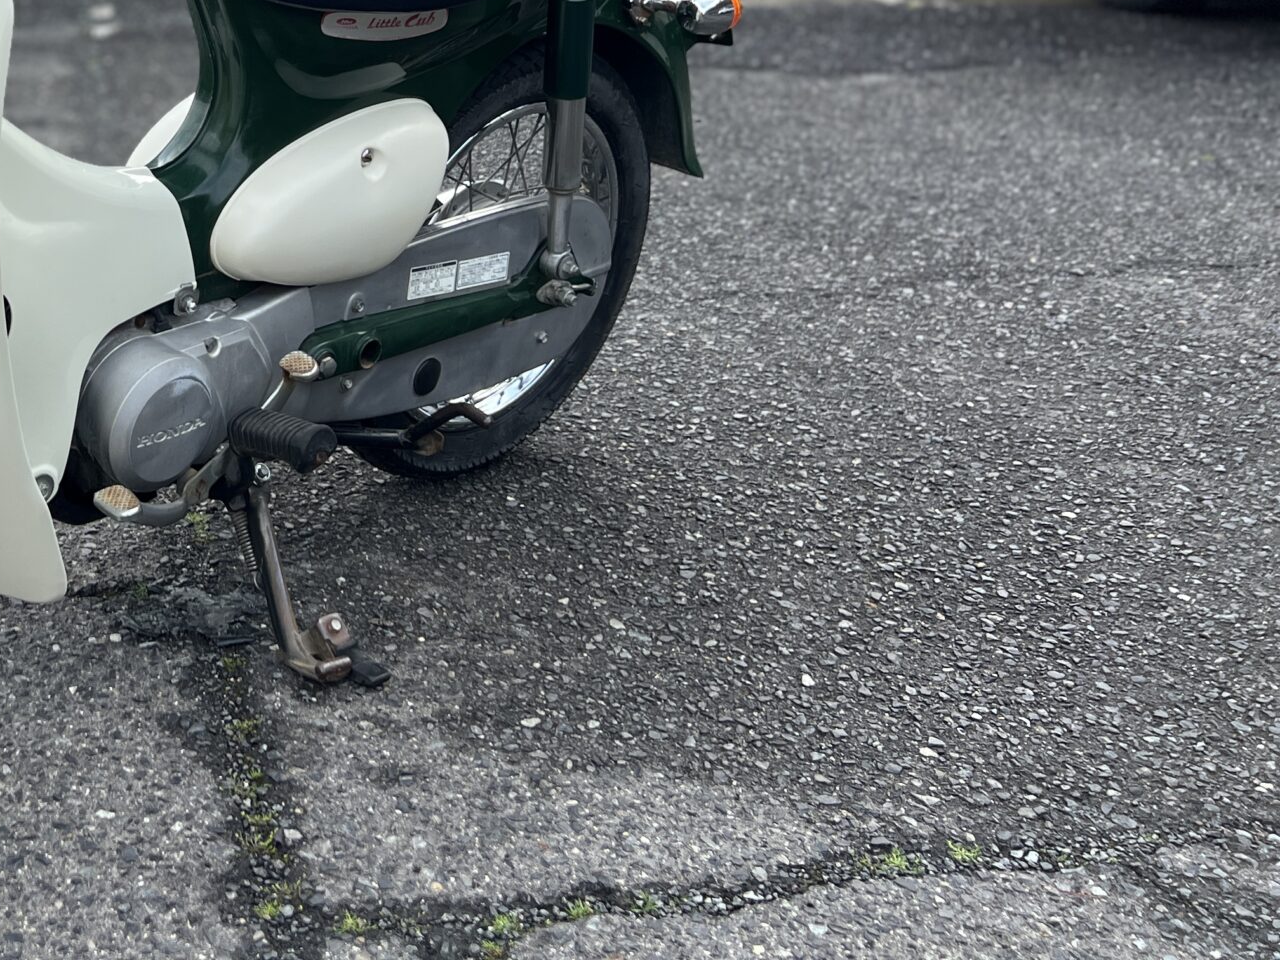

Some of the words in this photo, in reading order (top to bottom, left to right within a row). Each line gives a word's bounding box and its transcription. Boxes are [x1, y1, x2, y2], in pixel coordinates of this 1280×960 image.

[367, 16, 402, 29] Little
[404, 11, 436, 28] Cub
[136, 417, 207, 449] HONDA
